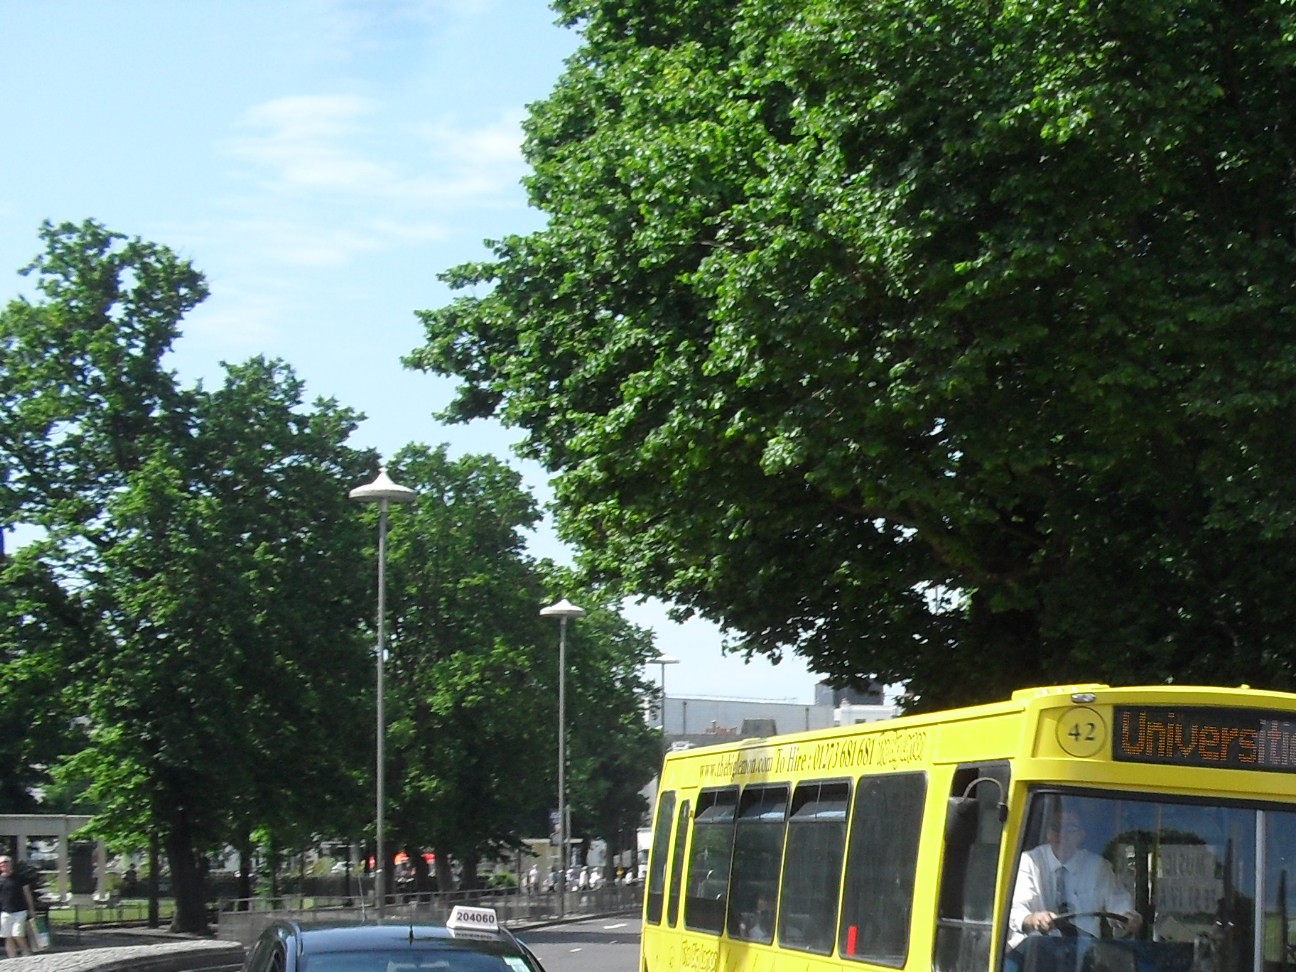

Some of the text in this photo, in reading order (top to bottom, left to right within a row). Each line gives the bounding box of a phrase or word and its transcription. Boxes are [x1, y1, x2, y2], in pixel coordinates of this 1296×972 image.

[1067, 722, 1096, 742] 42
[774, 748, 786, 773] To
[786, 745, 807, 771] Hire
[812, 741, 839, 769] 01273
[839, 739, 857, 767] 681
[857, 737, 875, 766] 681
[456, 911, 495, 924] 204060
